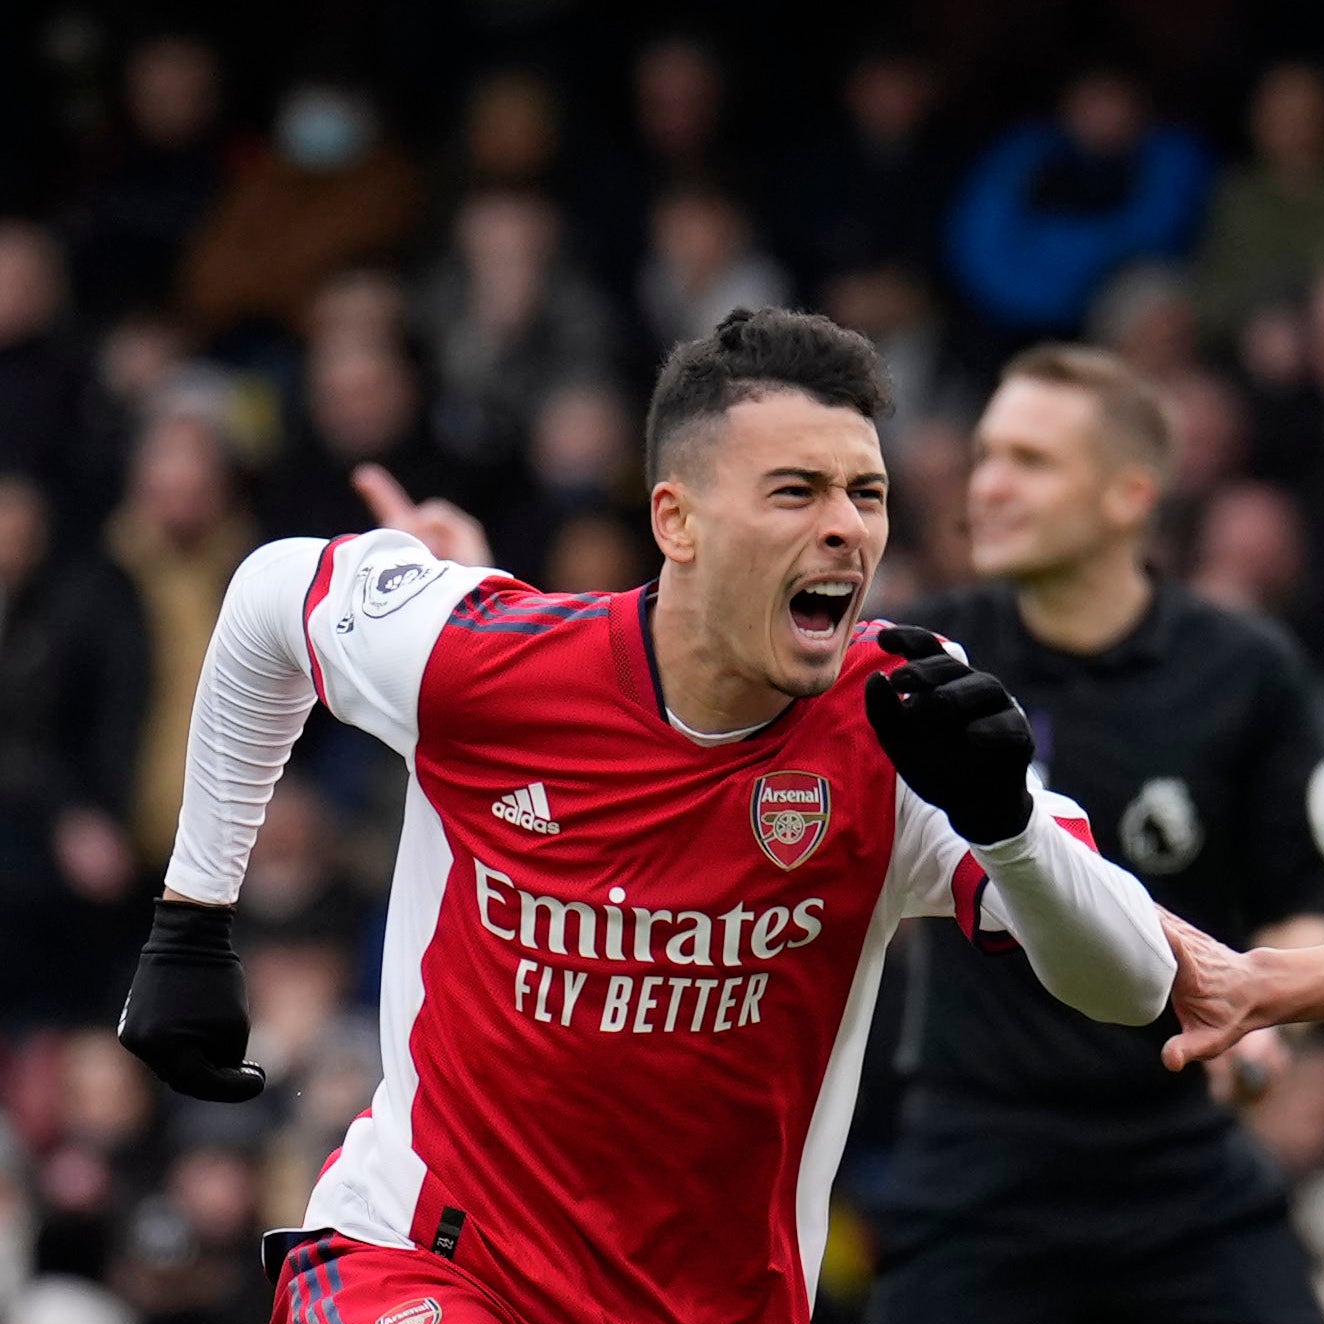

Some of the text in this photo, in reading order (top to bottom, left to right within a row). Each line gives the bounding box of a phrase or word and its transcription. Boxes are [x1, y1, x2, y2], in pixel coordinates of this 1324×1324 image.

[492, 801, 561, 835] adidas
[761, 785, 820, 804] Arsenal
[473, 856, 825, 967] Emirates
[515, 958, 770, 1033] FLY BETTER
